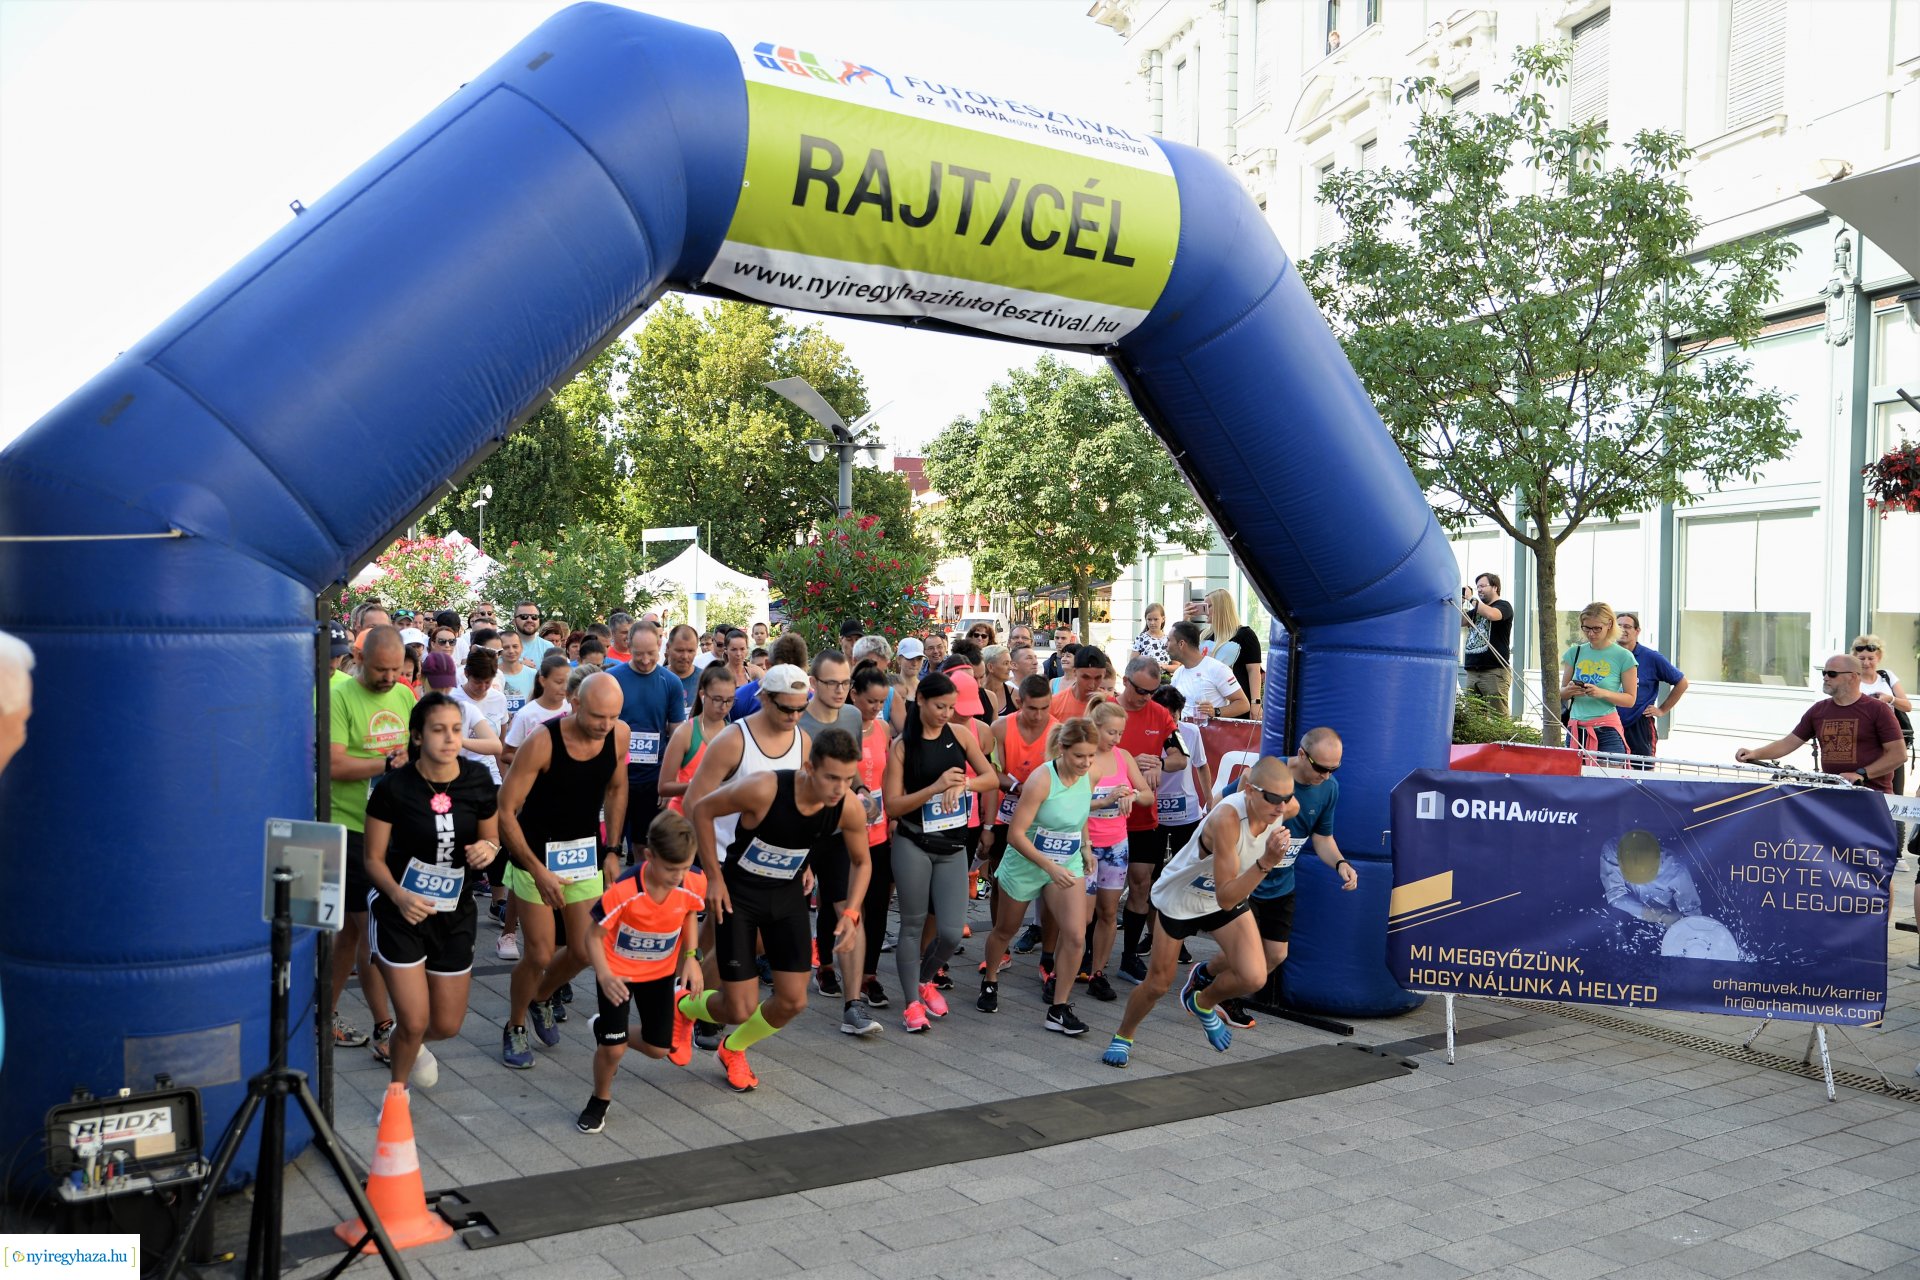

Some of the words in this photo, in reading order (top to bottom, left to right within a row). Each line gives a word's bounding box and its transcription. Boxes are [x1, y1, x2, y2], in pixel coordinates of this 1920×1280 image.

[917, 94, 935, 106] az
[1045, 123, 1149, 157] támogatásával
[792, 134, 1136, 268] RAJT/CÉL
[733, 260, 1121, 335] www.nyiregyhazifutofesztival.hu
[507, 701, 520, 709] 98
[629, 740, 653, 751] 584
[1003, 800, 1018, 813] 58
[1042, 838, 1073, 851] 582
[1284, 844, 1303, 856] 96
[1754, 838, 1824, 863] GYŐZZ
[1831, 846, 1885, 870] MEG,
[557, 848, 588, 866] 629
[757, 851, 794, 867] 624
[415, 873, 455, 894] 590
[1730, 865, 1790, 885] HOGY
[1795, 868, 1823, 887] TE
[1828, 870, 1887, 891] VAGY
[324, 904, 335, 921] 7
[1761, 891, 1776, 908] A
[1782, 892, 1885, 915] LEGJOBB
[628, 937, 667, 950] 581
[1410, 945, 1433, 961] MI
[1439, 947, 1585, 976] MEGGYŐZÜNK,
[1410, 968, 1464, 986] HOGY
[1469, 971, 1553, 995] NÁLUNK
[1558, 980, 1573, 996] A
[1579, 981, 1658, 1002] HELYED
[1713, 978, 1883, 1002] orhamuvek.hu/karrier
[1724, 996, 1882, 1020] hr@orhamuvek.com
